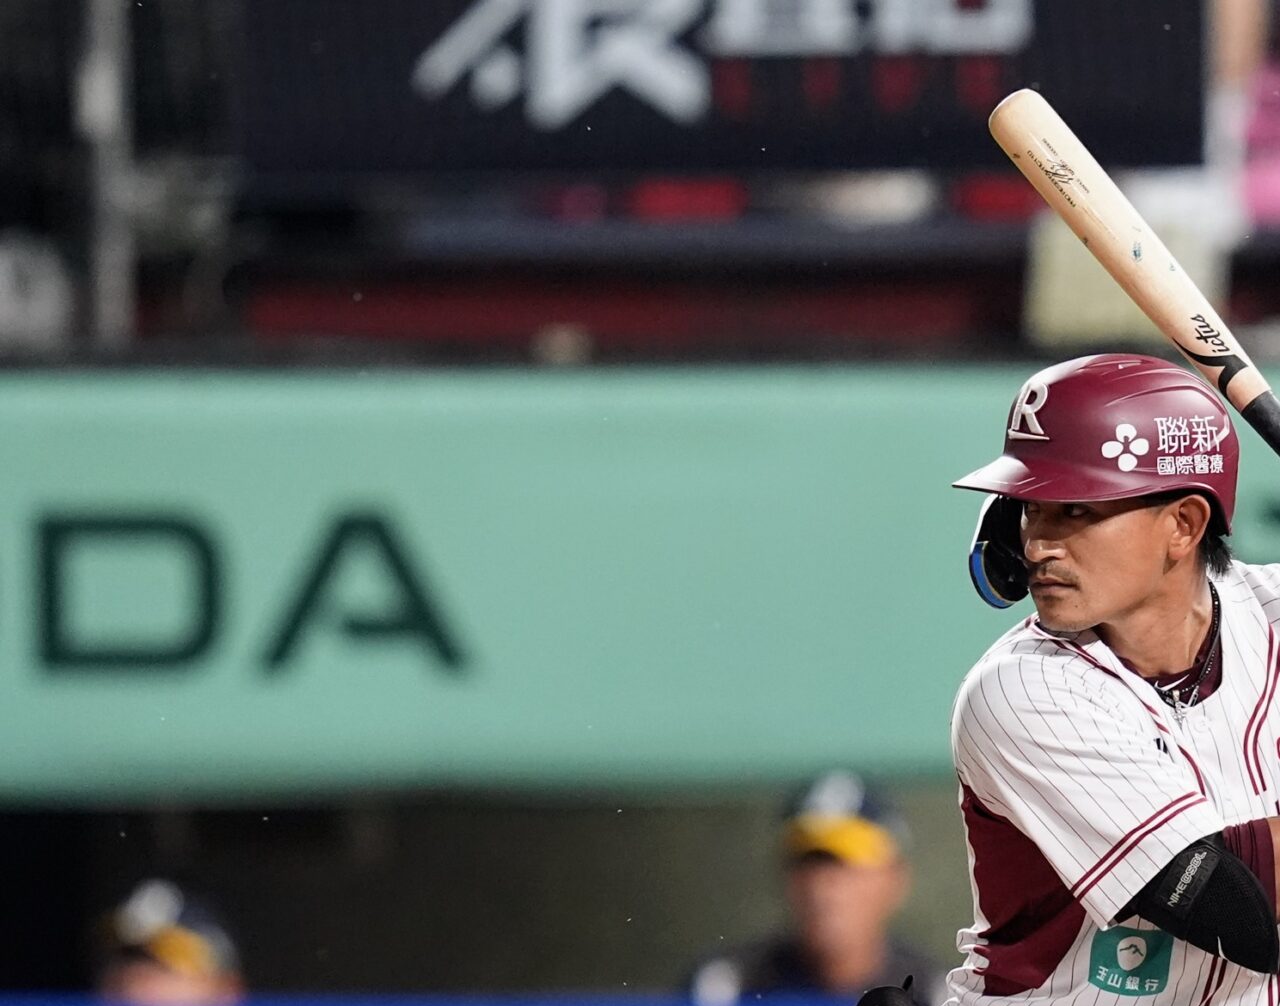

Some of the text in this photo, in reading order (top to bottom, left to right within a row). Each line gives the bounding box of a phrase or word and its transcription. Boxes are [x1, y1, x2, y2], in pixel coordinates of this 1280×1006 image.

[1008, 381, 1050, 440] R
[1154, 415, 1220, 453] 聯新
[1157, 454, 1224, 475] 國際醫療
[1096, 966, 1159, 991] 玉山銀行
